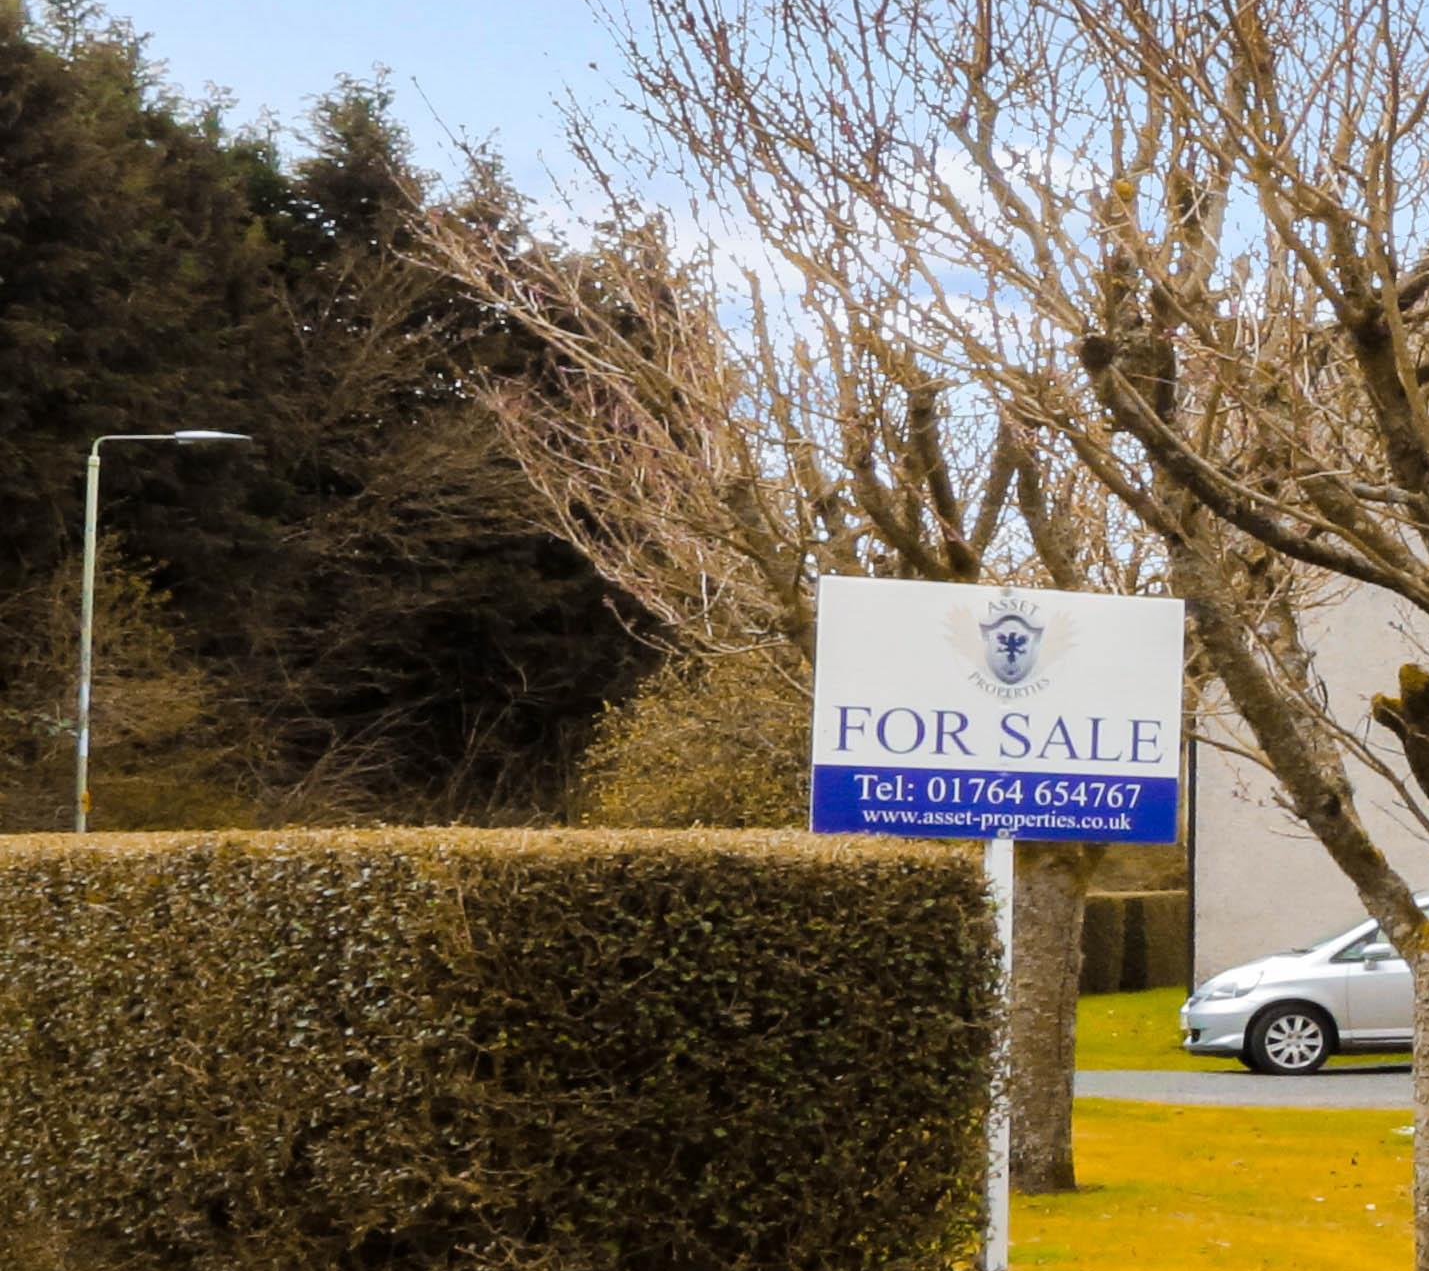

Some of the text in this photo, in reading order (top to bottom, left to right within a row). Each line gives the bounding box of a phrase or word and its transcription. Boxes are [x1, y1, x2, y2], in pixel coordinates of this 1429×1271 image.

[988, 598, 1039, 616] ASSET
[967, 671, 1050, 698] PROPERTIES
[833, 705, 1164, 764] FOR SALE
[854, 774, 1142, 809] Tel: 01764 654767
[862, 808, 1132, 831] www.asset-properties.co.uk
